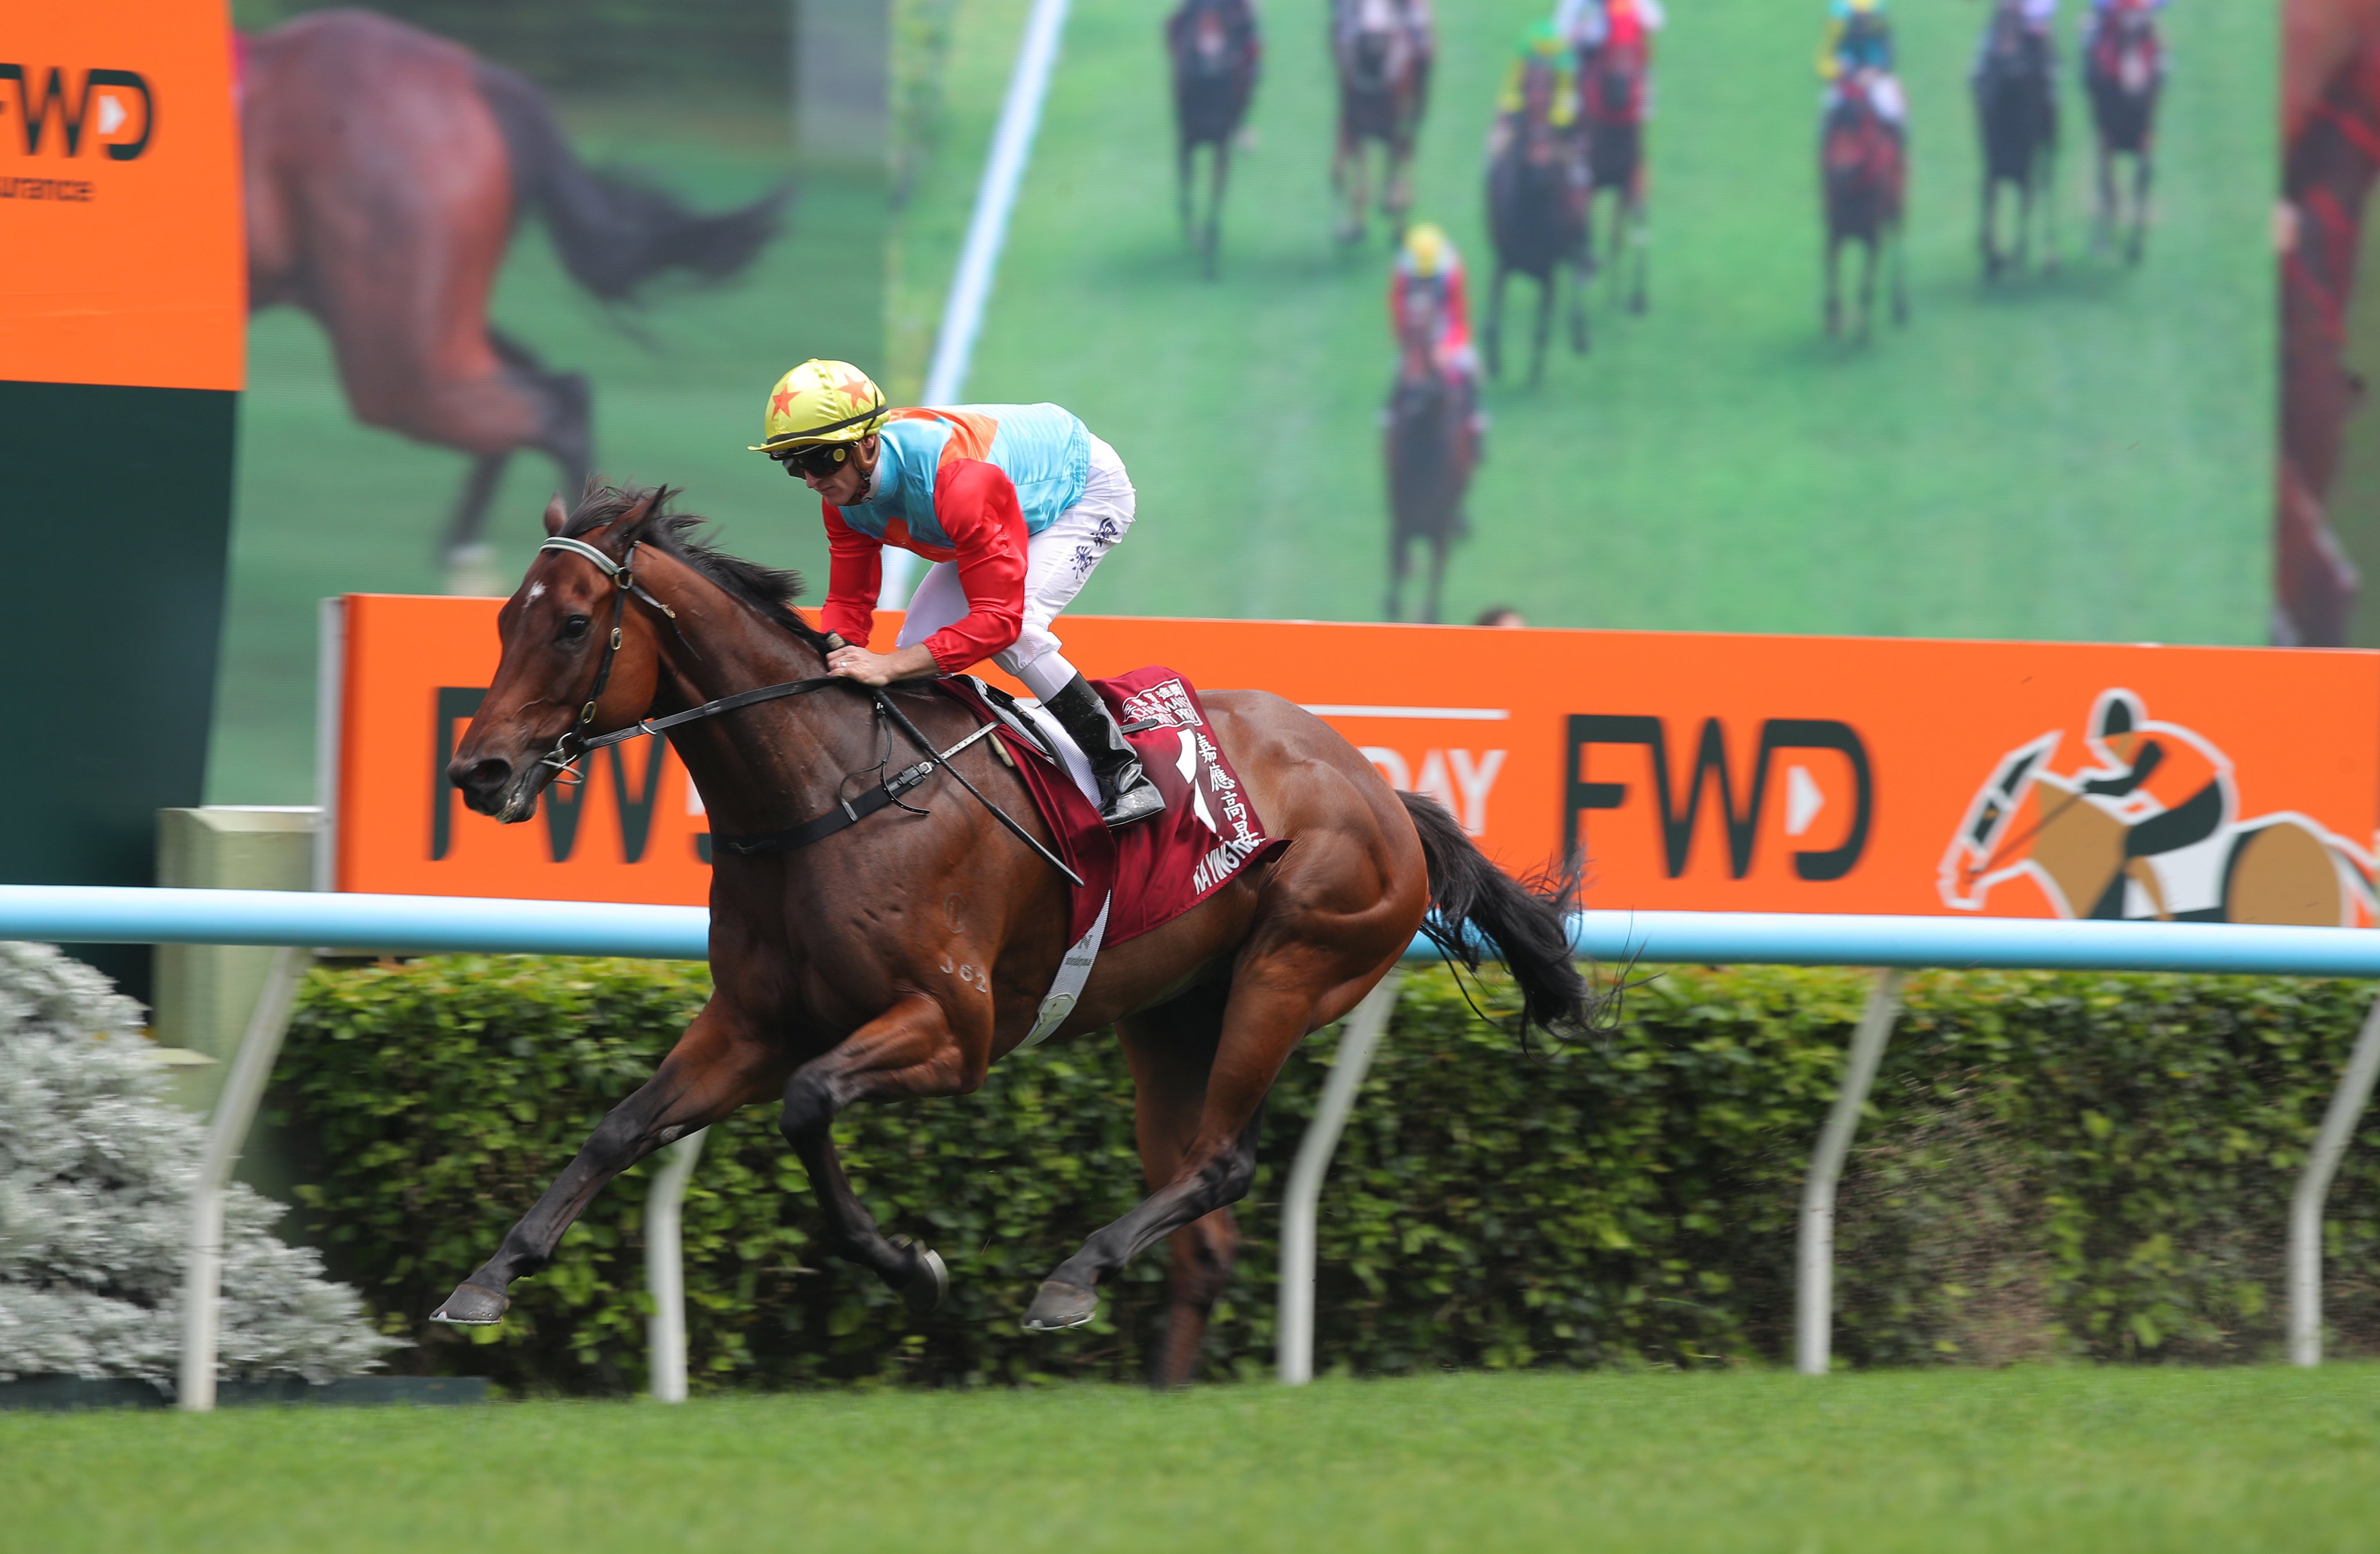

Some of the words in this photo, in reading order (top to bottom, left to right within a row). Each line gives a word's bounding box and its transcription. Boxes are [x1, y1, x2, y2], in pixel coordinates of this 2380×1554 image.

[429, 686, 713, 865] FW
[1196, 732, 1259, 842] 嘉應高昇
[1563, 714, 1875, 881] FWD
